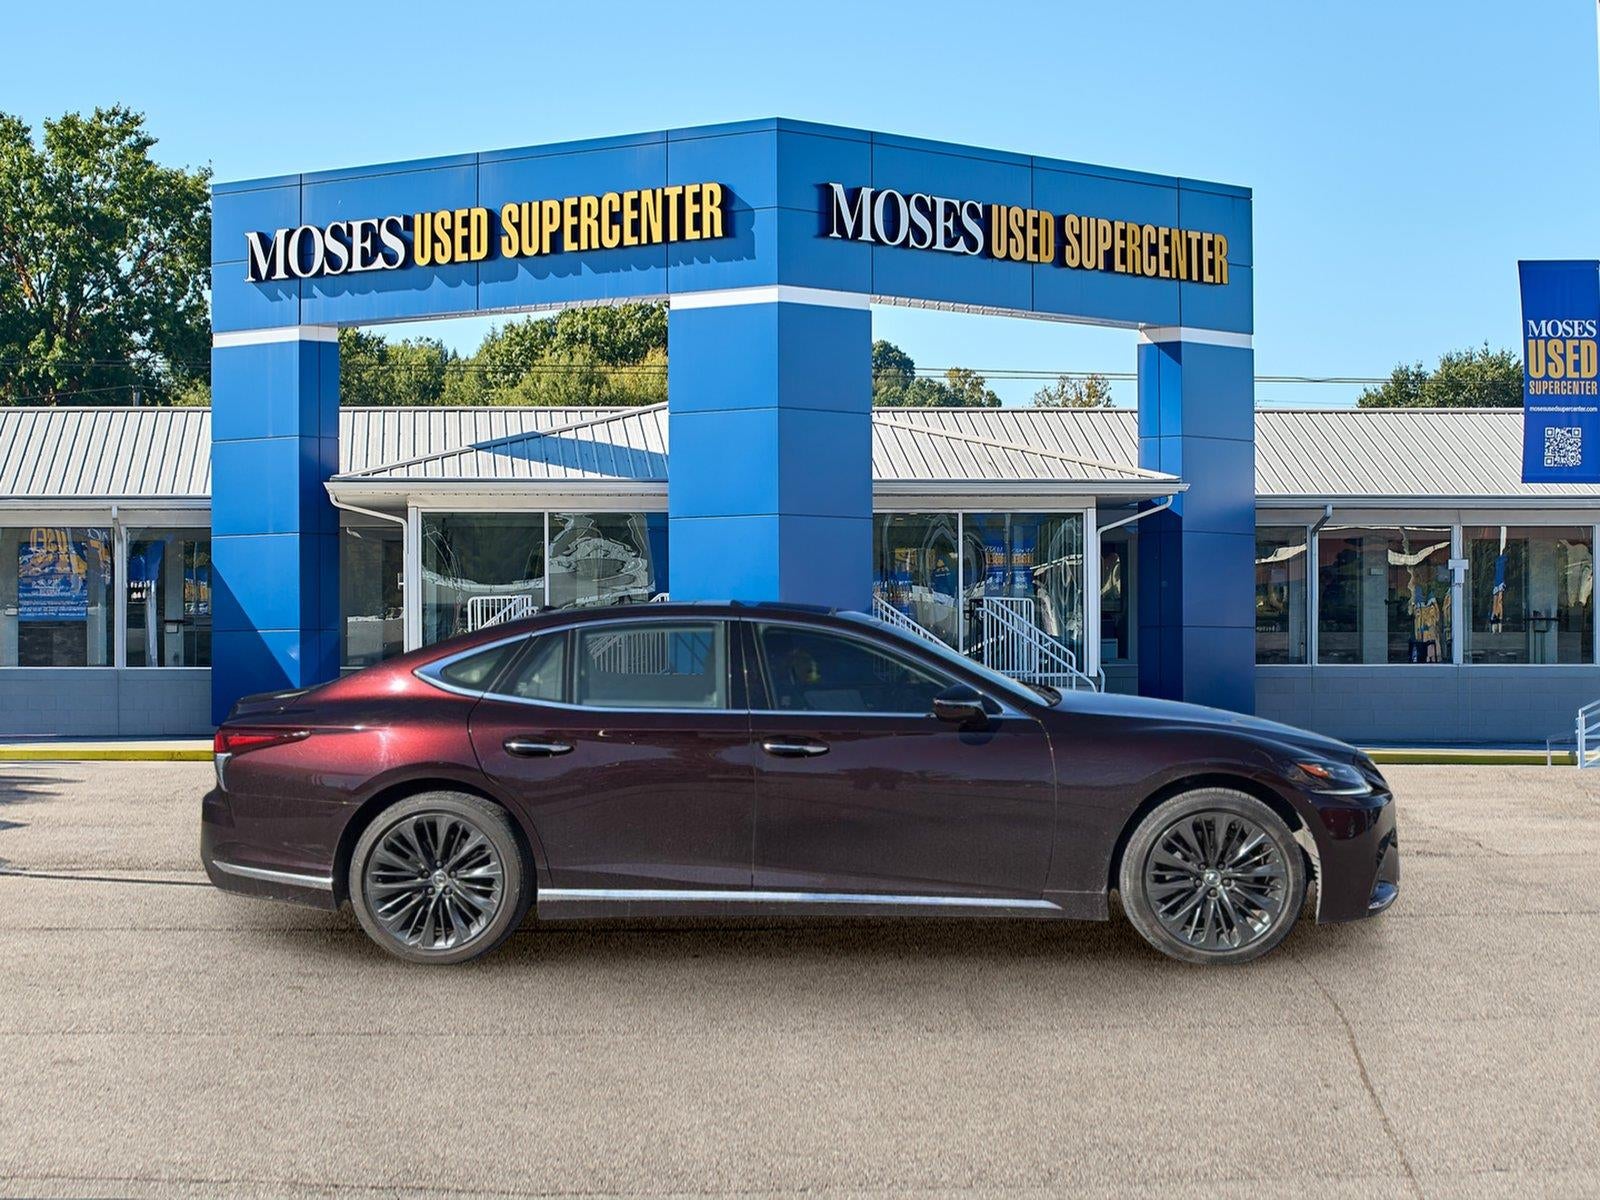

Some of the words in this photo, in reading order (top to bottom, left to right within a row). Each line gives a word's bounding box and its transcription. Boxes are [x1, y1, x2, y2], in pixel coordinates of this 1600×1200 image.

[245, 216, 406, 283] MOSES
[412, 207, 489, 266] USED
[502, 182, 724, 258] SUPERCENTER
[829, 183, 984, 255] MOSES
[991, 205, 1056, 264] USED
[1065, 214, 1229, 285] SUPERCENTER
[1527, 319, 1597, 338] MOSES
[1527, 339, 1598, 379] USED
[1529, 380, 1597, 395] SUPERCENTER
